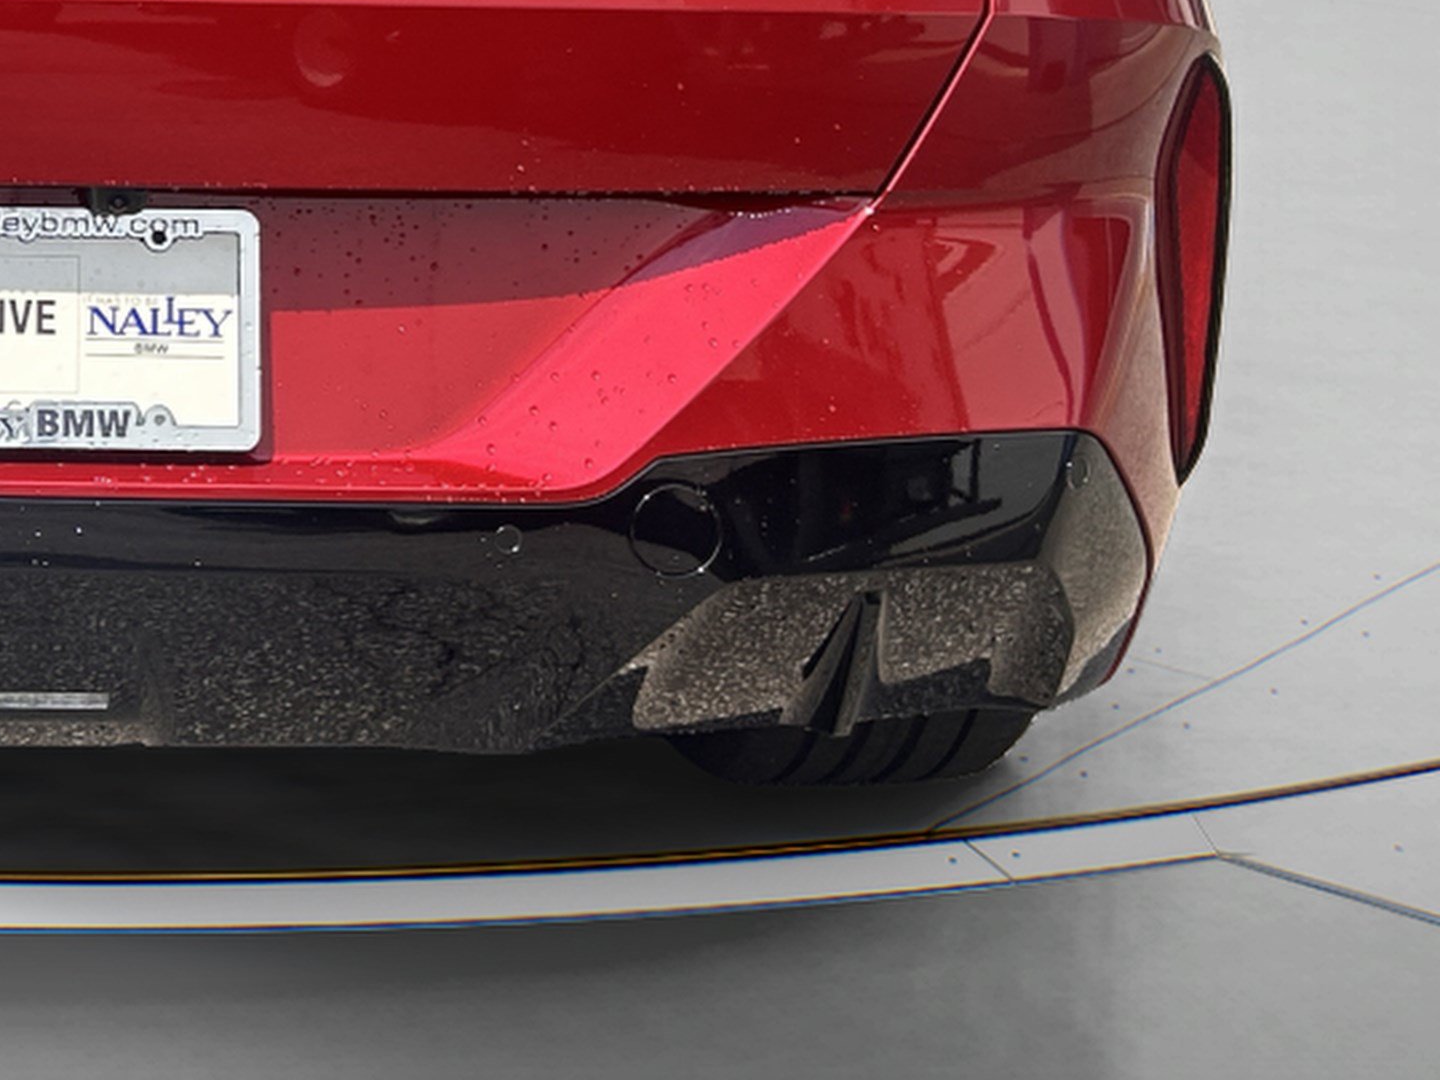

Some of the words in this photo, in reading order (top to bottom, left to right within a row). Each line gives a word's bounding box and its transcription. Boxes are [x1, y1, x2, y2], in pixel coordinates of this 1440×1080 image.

[86, 296, 233, 338] NALLEY
[133, 343, 169, 355] BMW
[36, 409, 132, 438] BMW
